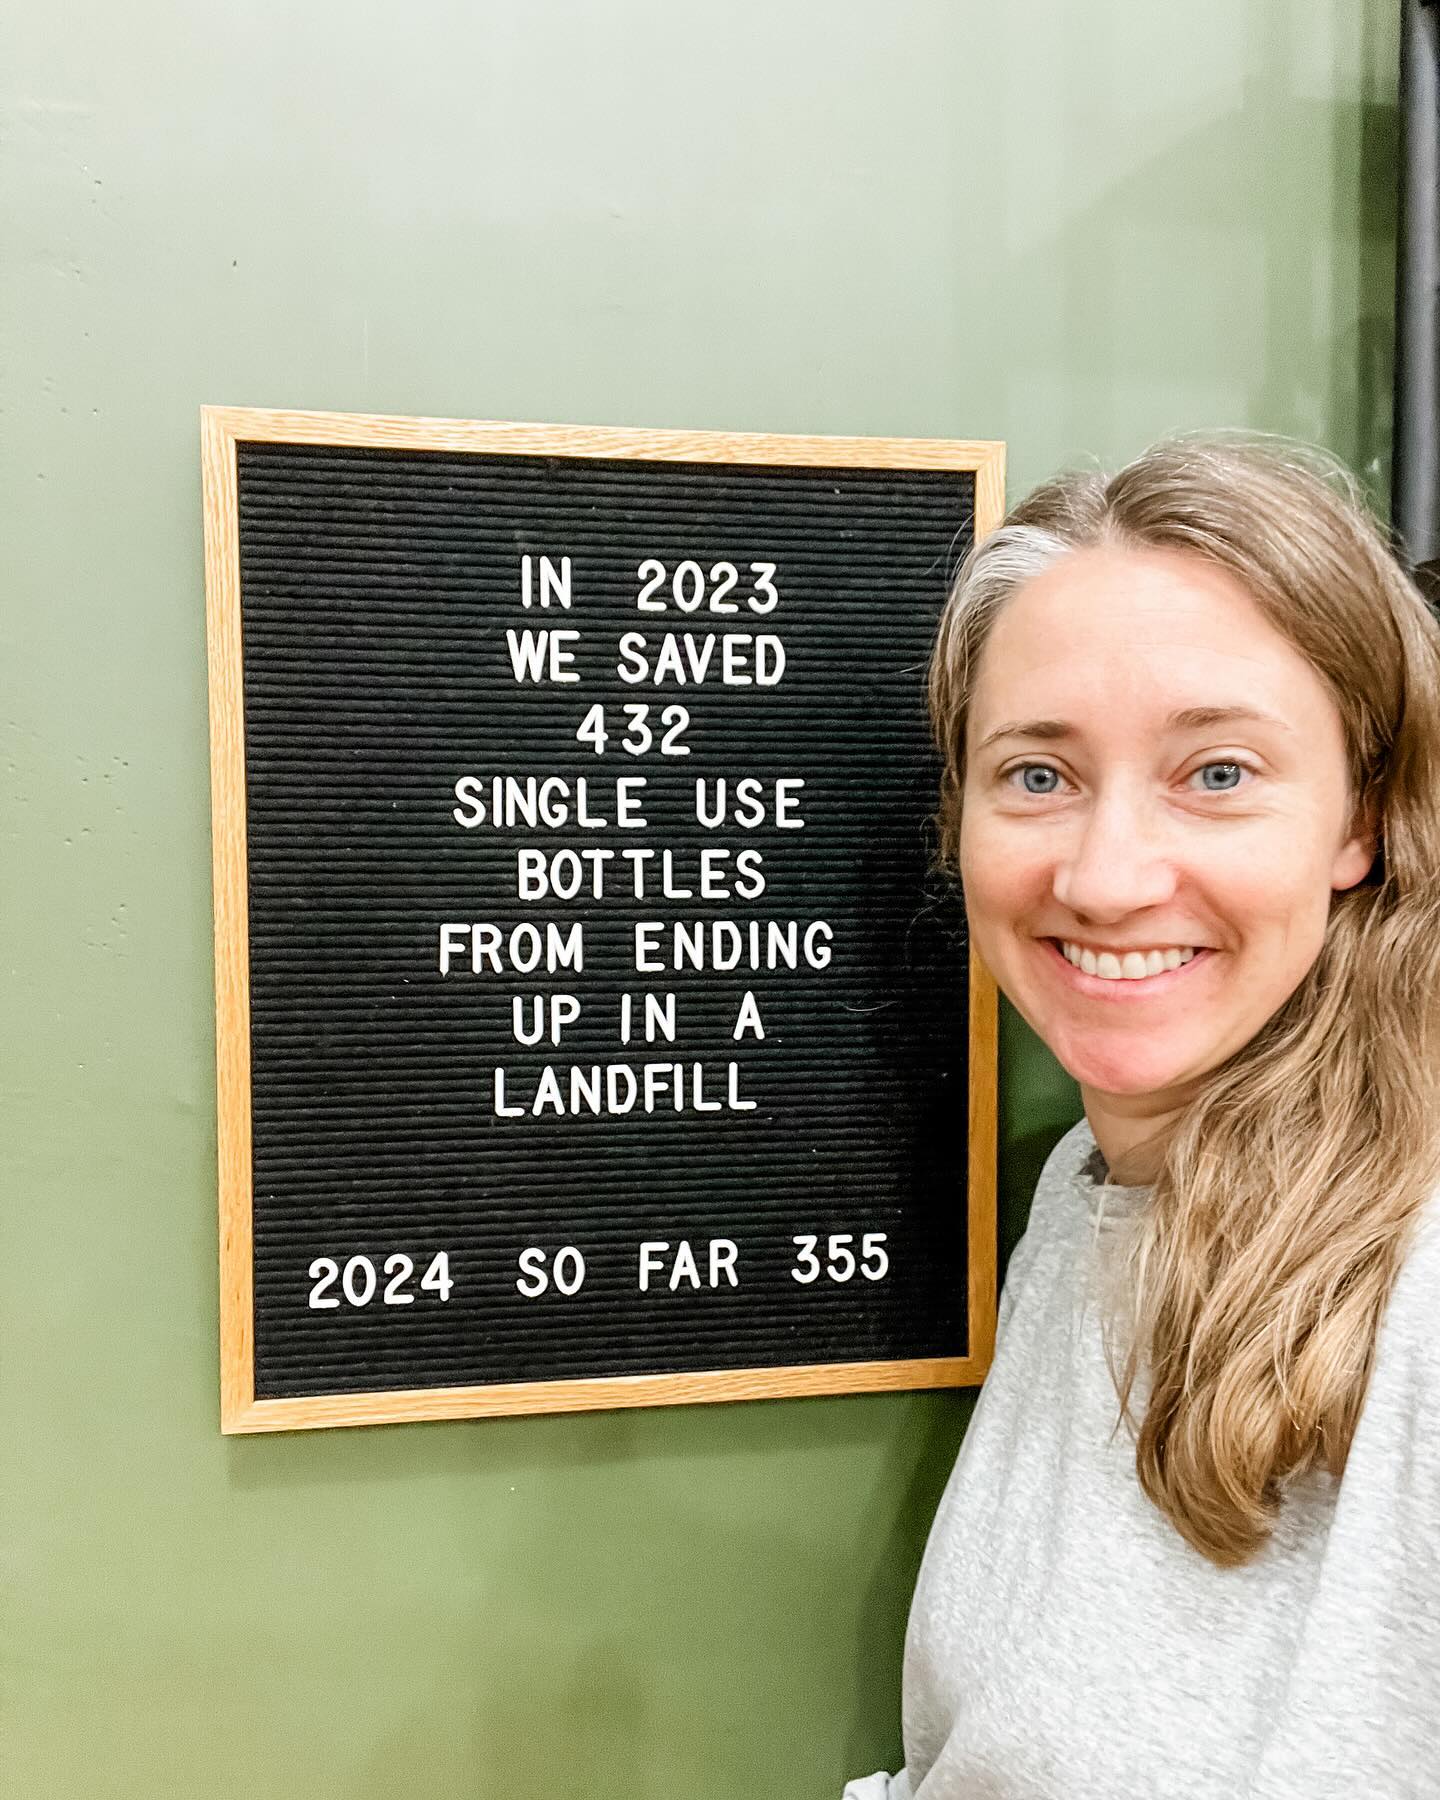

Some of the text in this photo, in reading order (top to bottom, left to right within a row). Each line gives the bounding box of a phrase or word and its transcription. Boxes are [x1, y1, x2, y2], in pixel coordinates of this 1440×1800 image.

[521, 554, 779, 615] IN 2023
[505, 628, 786, 687] WE SAVED
[576, 703, 691, 757] 432
[452, 776, 805, 830] SINGLE USE
[517, 848, 766, 902] BOTTLES
[439, 920, 834, 978] FROM ENDING
[512, 990, 765, 1047] UP IN A
[494, 1061, 758, 1118] LANDFILL
[308, 1232, 889, 1309] 2024 SO FAR 355
